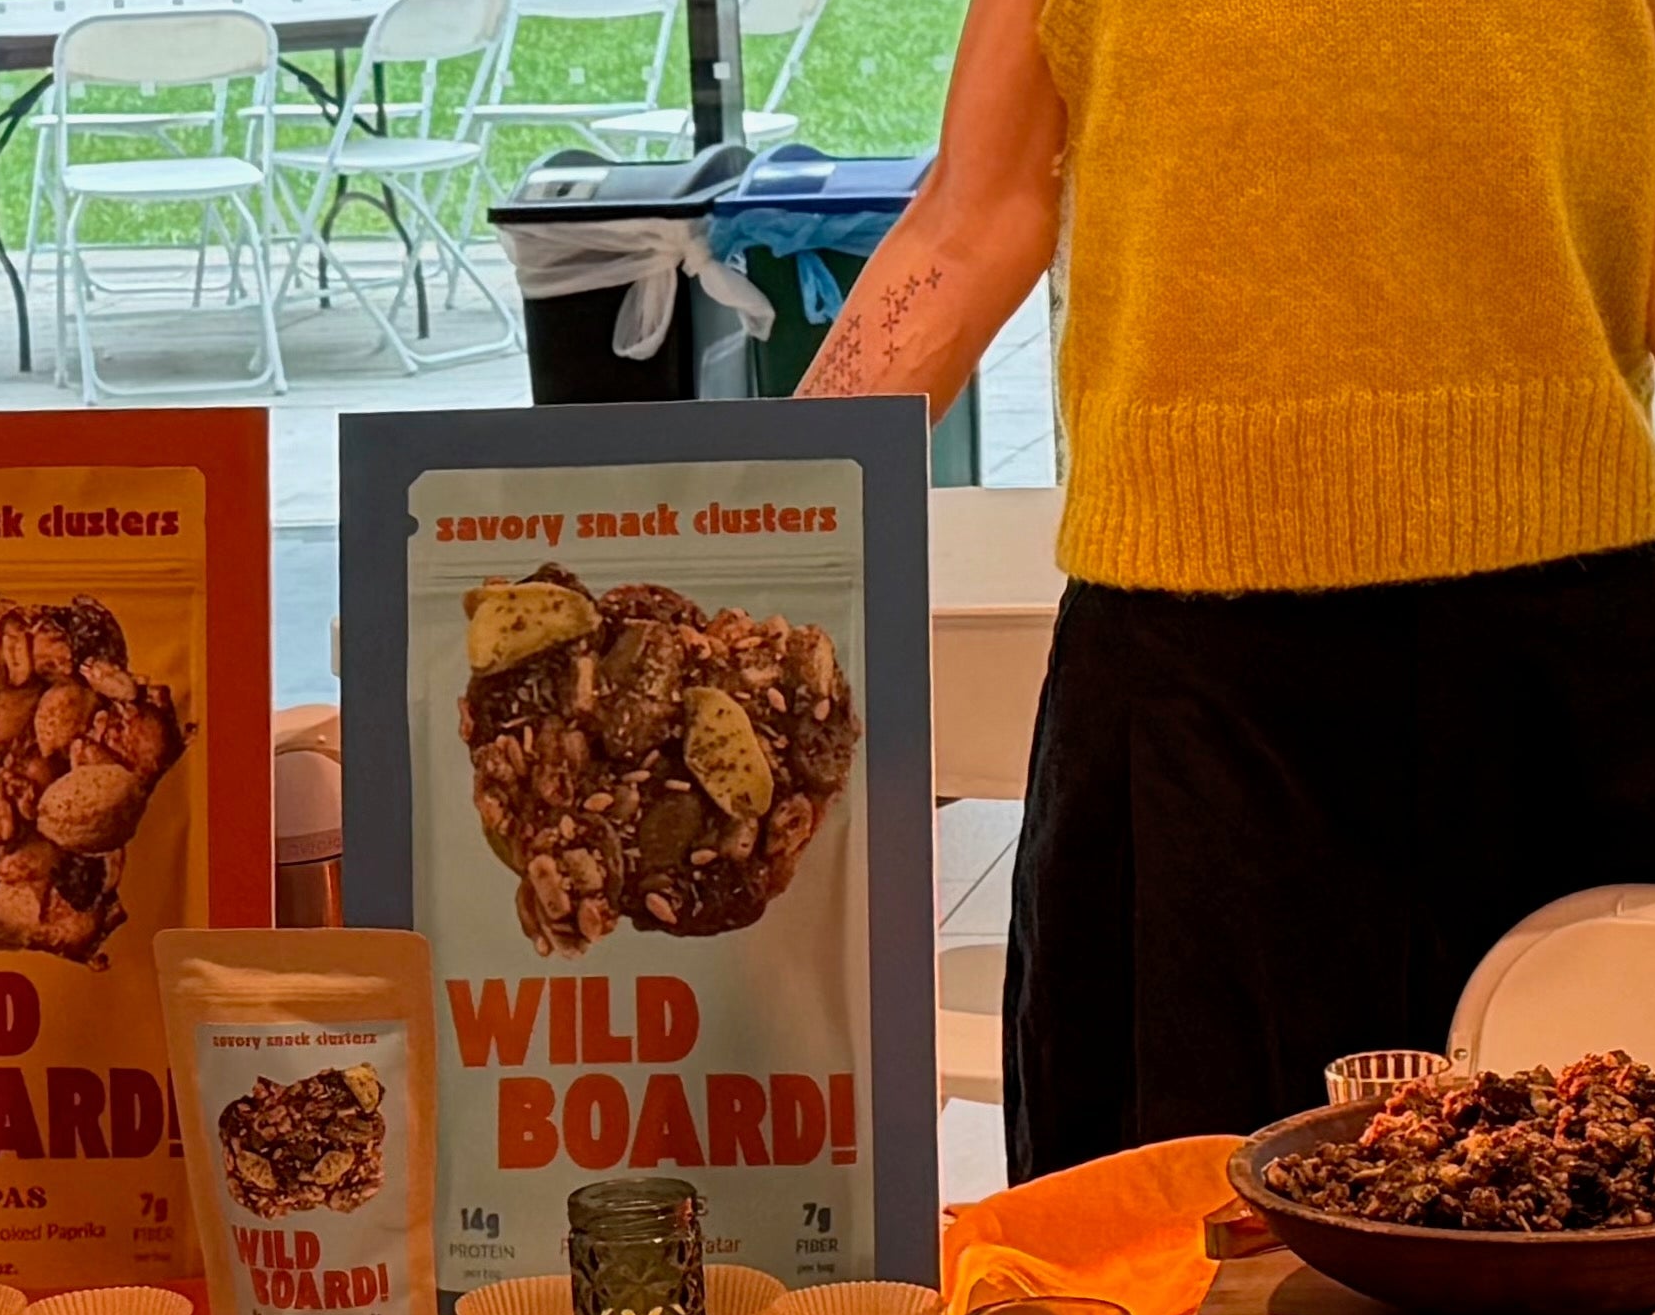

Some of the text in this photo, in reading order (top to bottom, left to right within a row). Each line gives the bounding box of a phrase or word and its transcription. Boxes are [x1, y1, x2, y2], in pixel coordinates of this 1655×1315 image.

[38, 505, 179, 537] clusters
[436, 501, 837, 546] savory snack clusters
[446, 975, 700, 1068] WILD
[497, 1072, 857, 1170] BOARD!
[139, 1192, 169, 1223] 7g
[460, 1207, 500, 1239] 14g
[803, 1203, 831, 1233] 7g
[47, 1222, 106, 1242] Paprika
[232, 1224, 321, 1270] WILD
[796, 1238, 838, 1253] FIBER
[449, 1243, 515, 1259] PROTEIN
[250, 1262, 389, 1310] BOARD!
